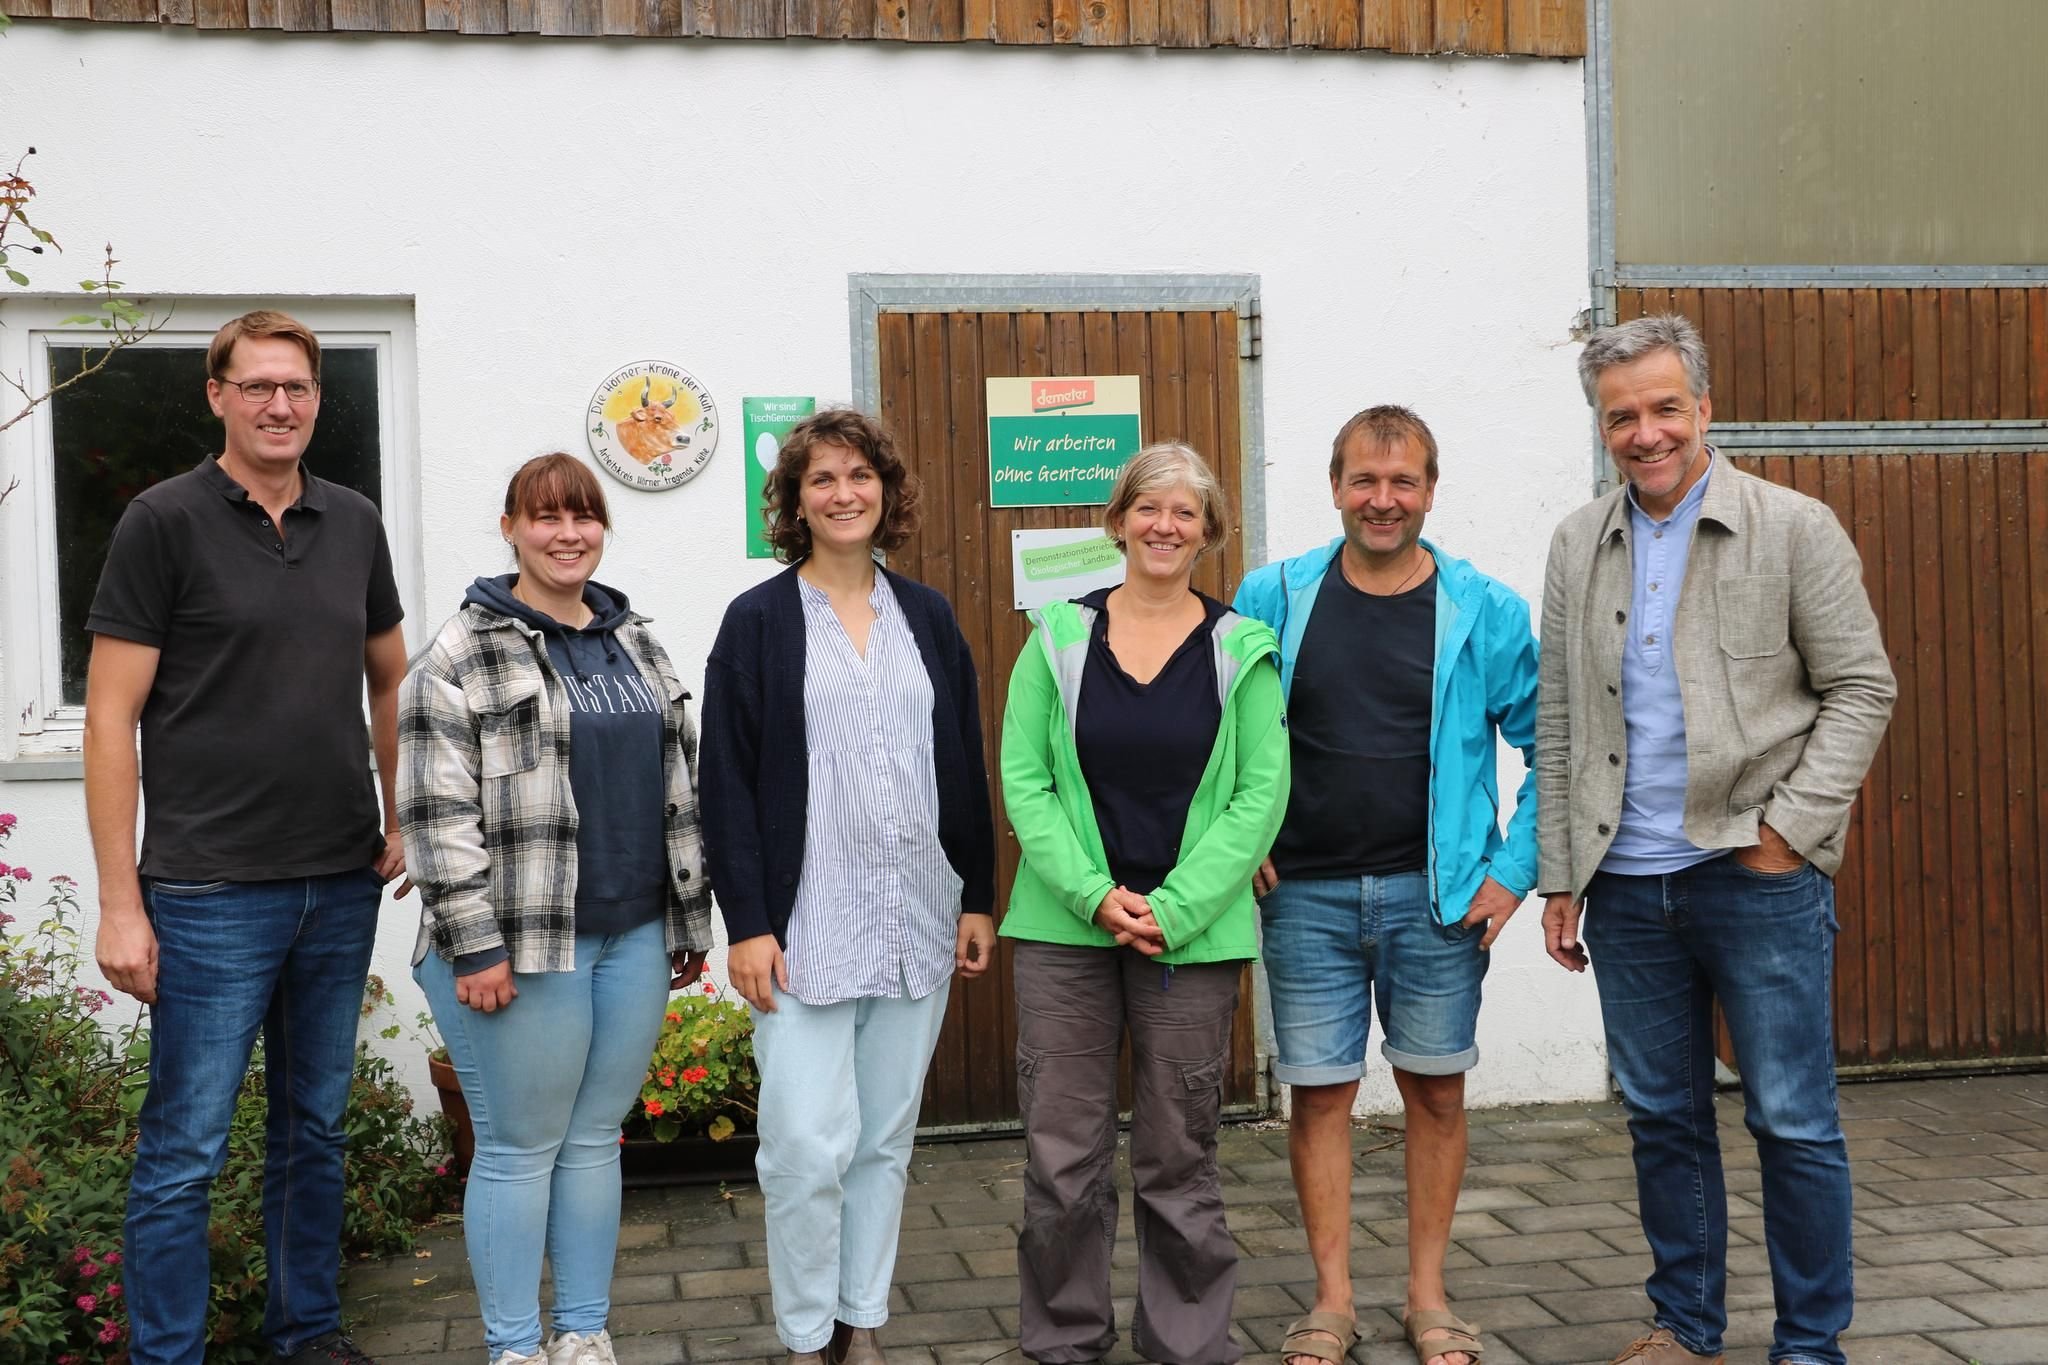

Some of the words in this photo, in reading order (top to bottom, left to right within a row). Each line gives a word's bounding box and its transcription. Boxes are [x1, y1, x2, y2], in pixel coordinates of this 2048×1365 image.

[591, 394, 607, 415] Die
[682, 376, 699, 394] der
[697, 392, 713, 413] Kuh
[1036, 388, 1088, 406] demeter
[763, 402, 778, 412] Wir
[779, 402, 797, 411] sind
[1014, 436, 1041, 452] Wir
[1045, 433, 1116, 452] arbeiten
[598, 448, 633, 482] Arbeitskreis
[664, 466, 694, 485] tragende
[694, 447, 710, 465] Kühe
[994, 465, 1033, 483] ohne
[1030, 560, 1082, 576] Ökologischer
[1082, 553, 1115, 566] Landbau
[563, 674, 662, 714] USTAN
